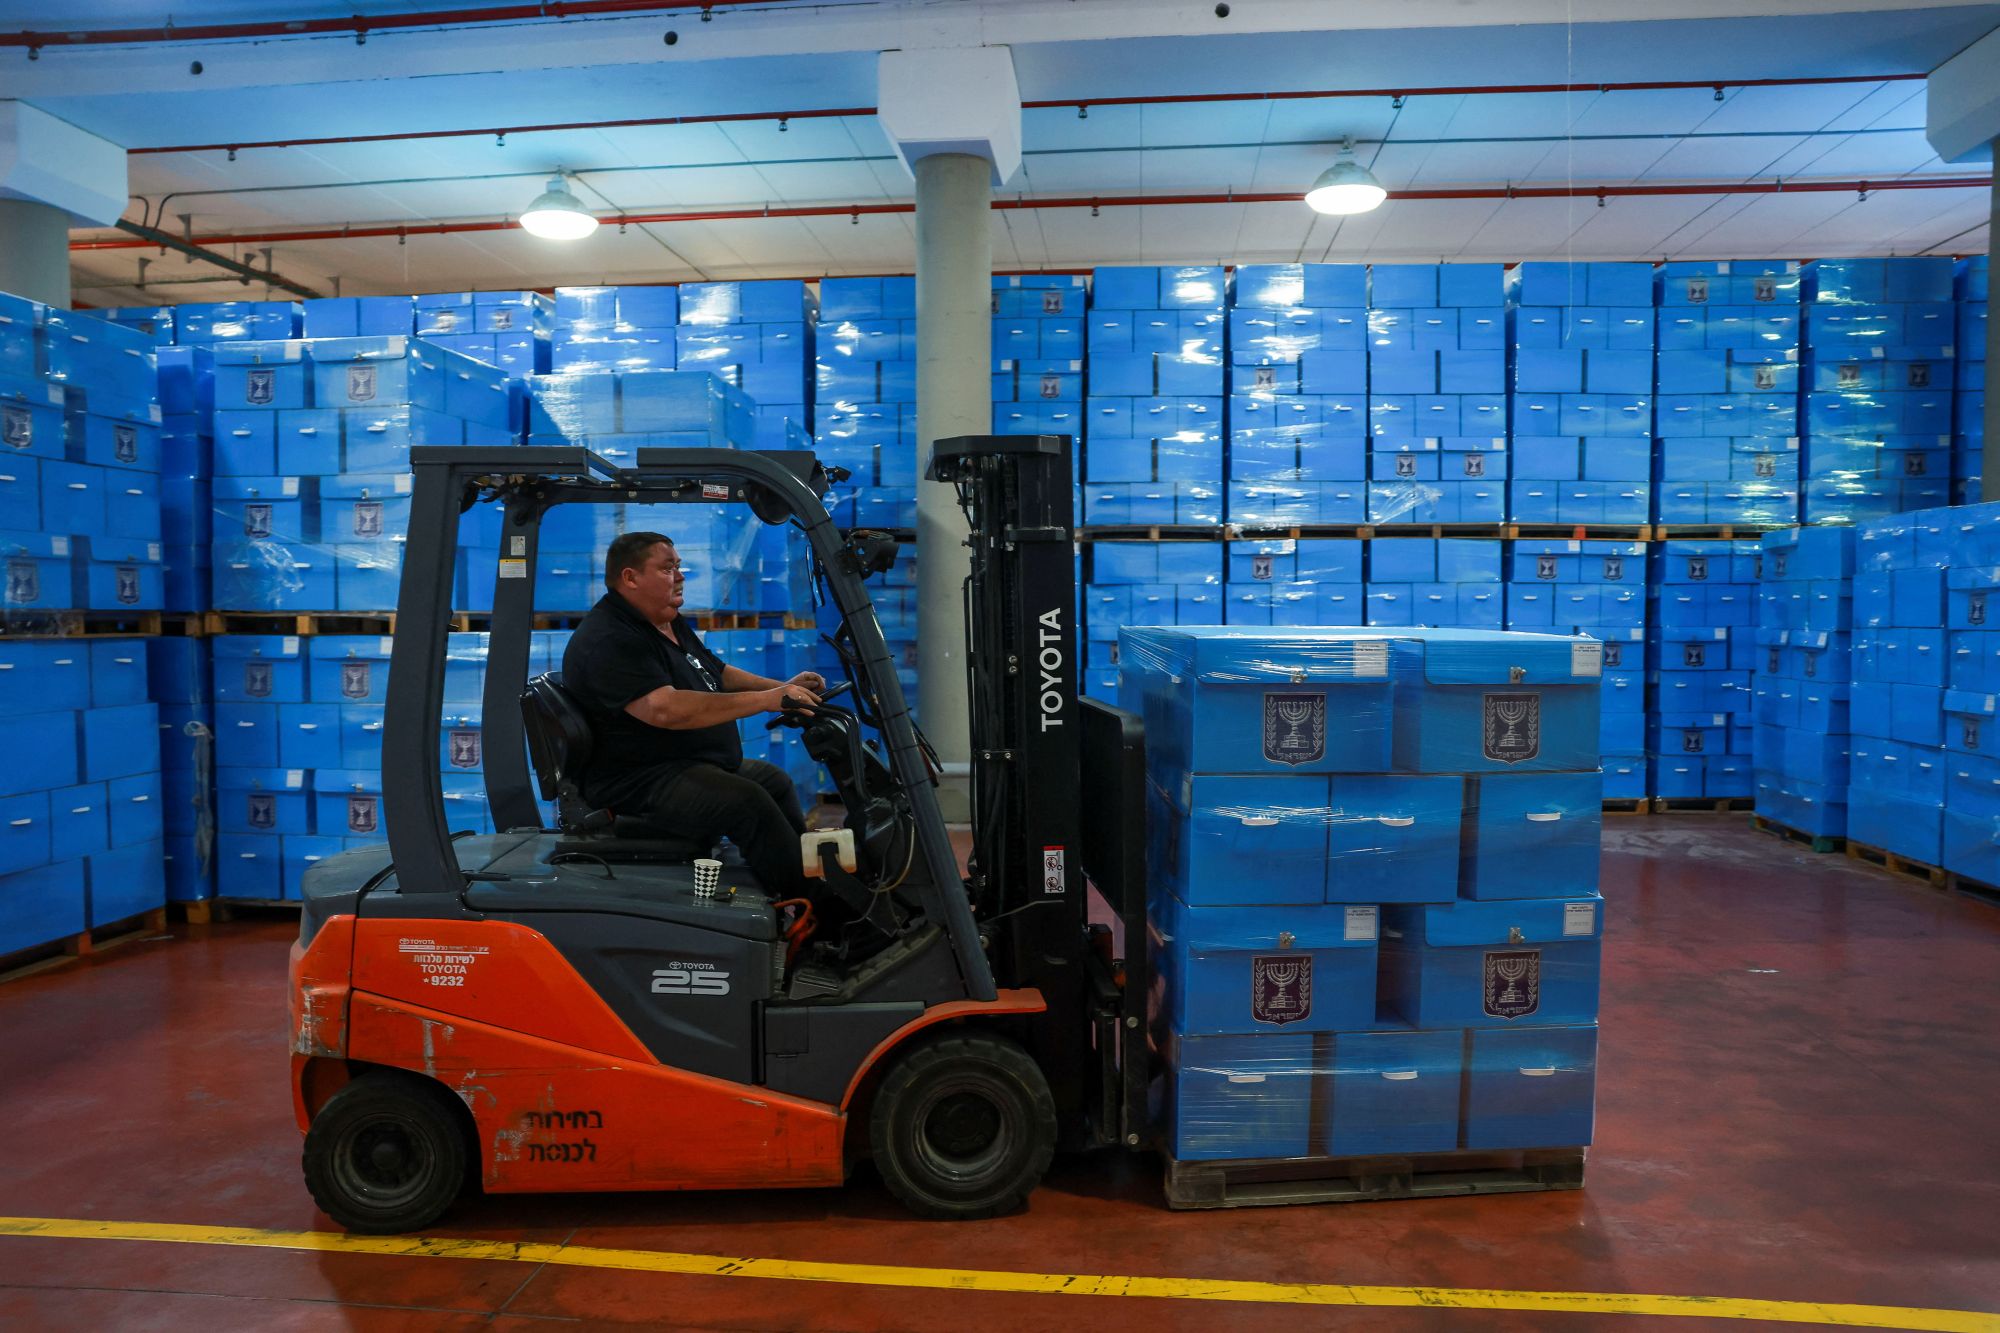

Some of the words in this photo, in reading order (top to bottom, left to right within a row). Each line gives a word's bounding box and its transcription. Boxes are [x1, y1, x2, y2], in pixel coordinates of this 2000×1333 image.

[1039, 607, 1063, 732] TOYOTA
[420, 964, 467, 974] TOYOTA
[683, 962, 714, 970] TOYOTA
[651, 969, 730, 996] 25
[526, 1110, 603, 1129] בחירות
[528, 1137, 597, 1163] לכנסת
